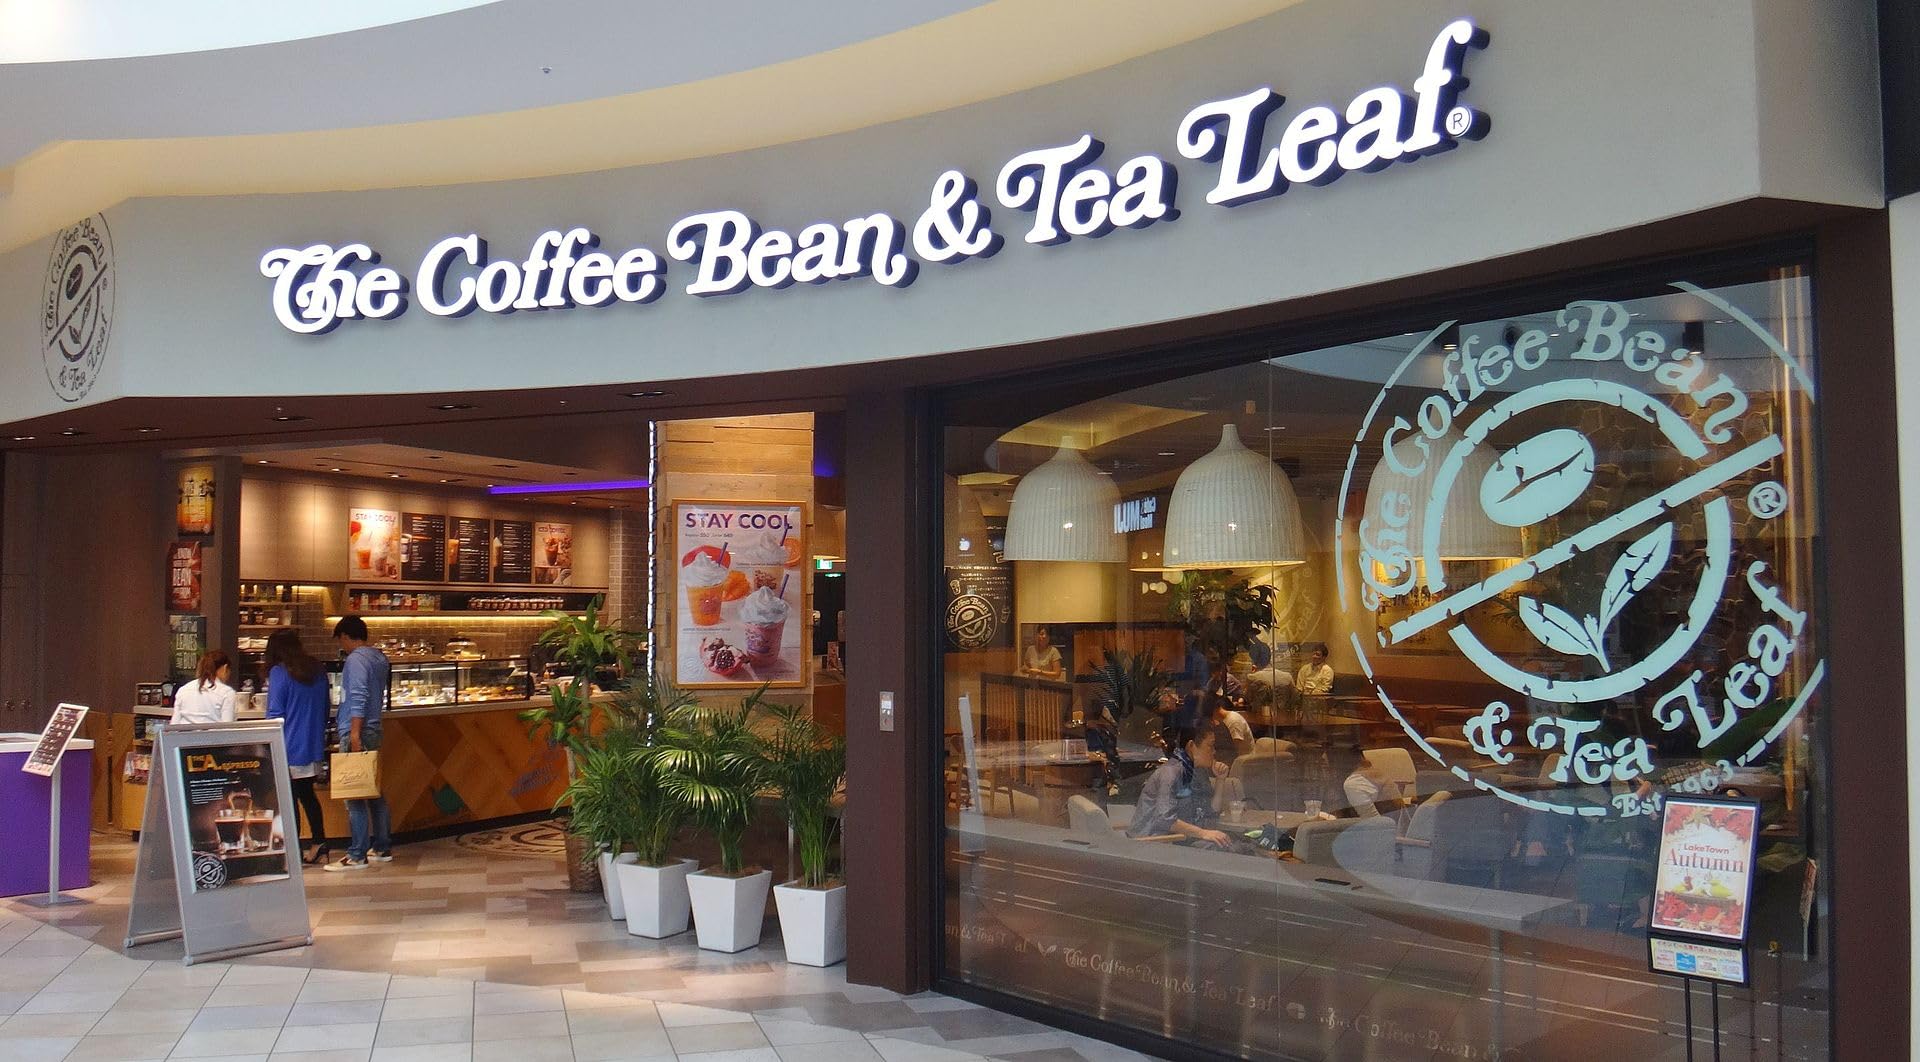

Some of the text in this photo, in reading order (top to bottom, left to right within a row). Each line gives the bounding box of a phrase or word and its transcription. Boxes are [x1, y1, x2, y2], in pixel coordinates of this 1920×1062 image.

[261, 243, 400, 334] The
[416, 228, 658, 316] Coffee
[666, 210, 907, 296] Bean
[912, 169, 992, 262] &
[996, 134, 1167, 245] Tea
[1176, 19, 1473, 204] Leaf
[68, 367, 87, 391] Tea
[1358, 300, 1749, 611] The Coffee Bean
[686, 513, 793, 530] STAY COOL
[1462, 560, 1807, 785] & Tea Leaf
[1664, 848, 1744, 873] Autumn
[1684, 843, 1729, 855] LakeTown
